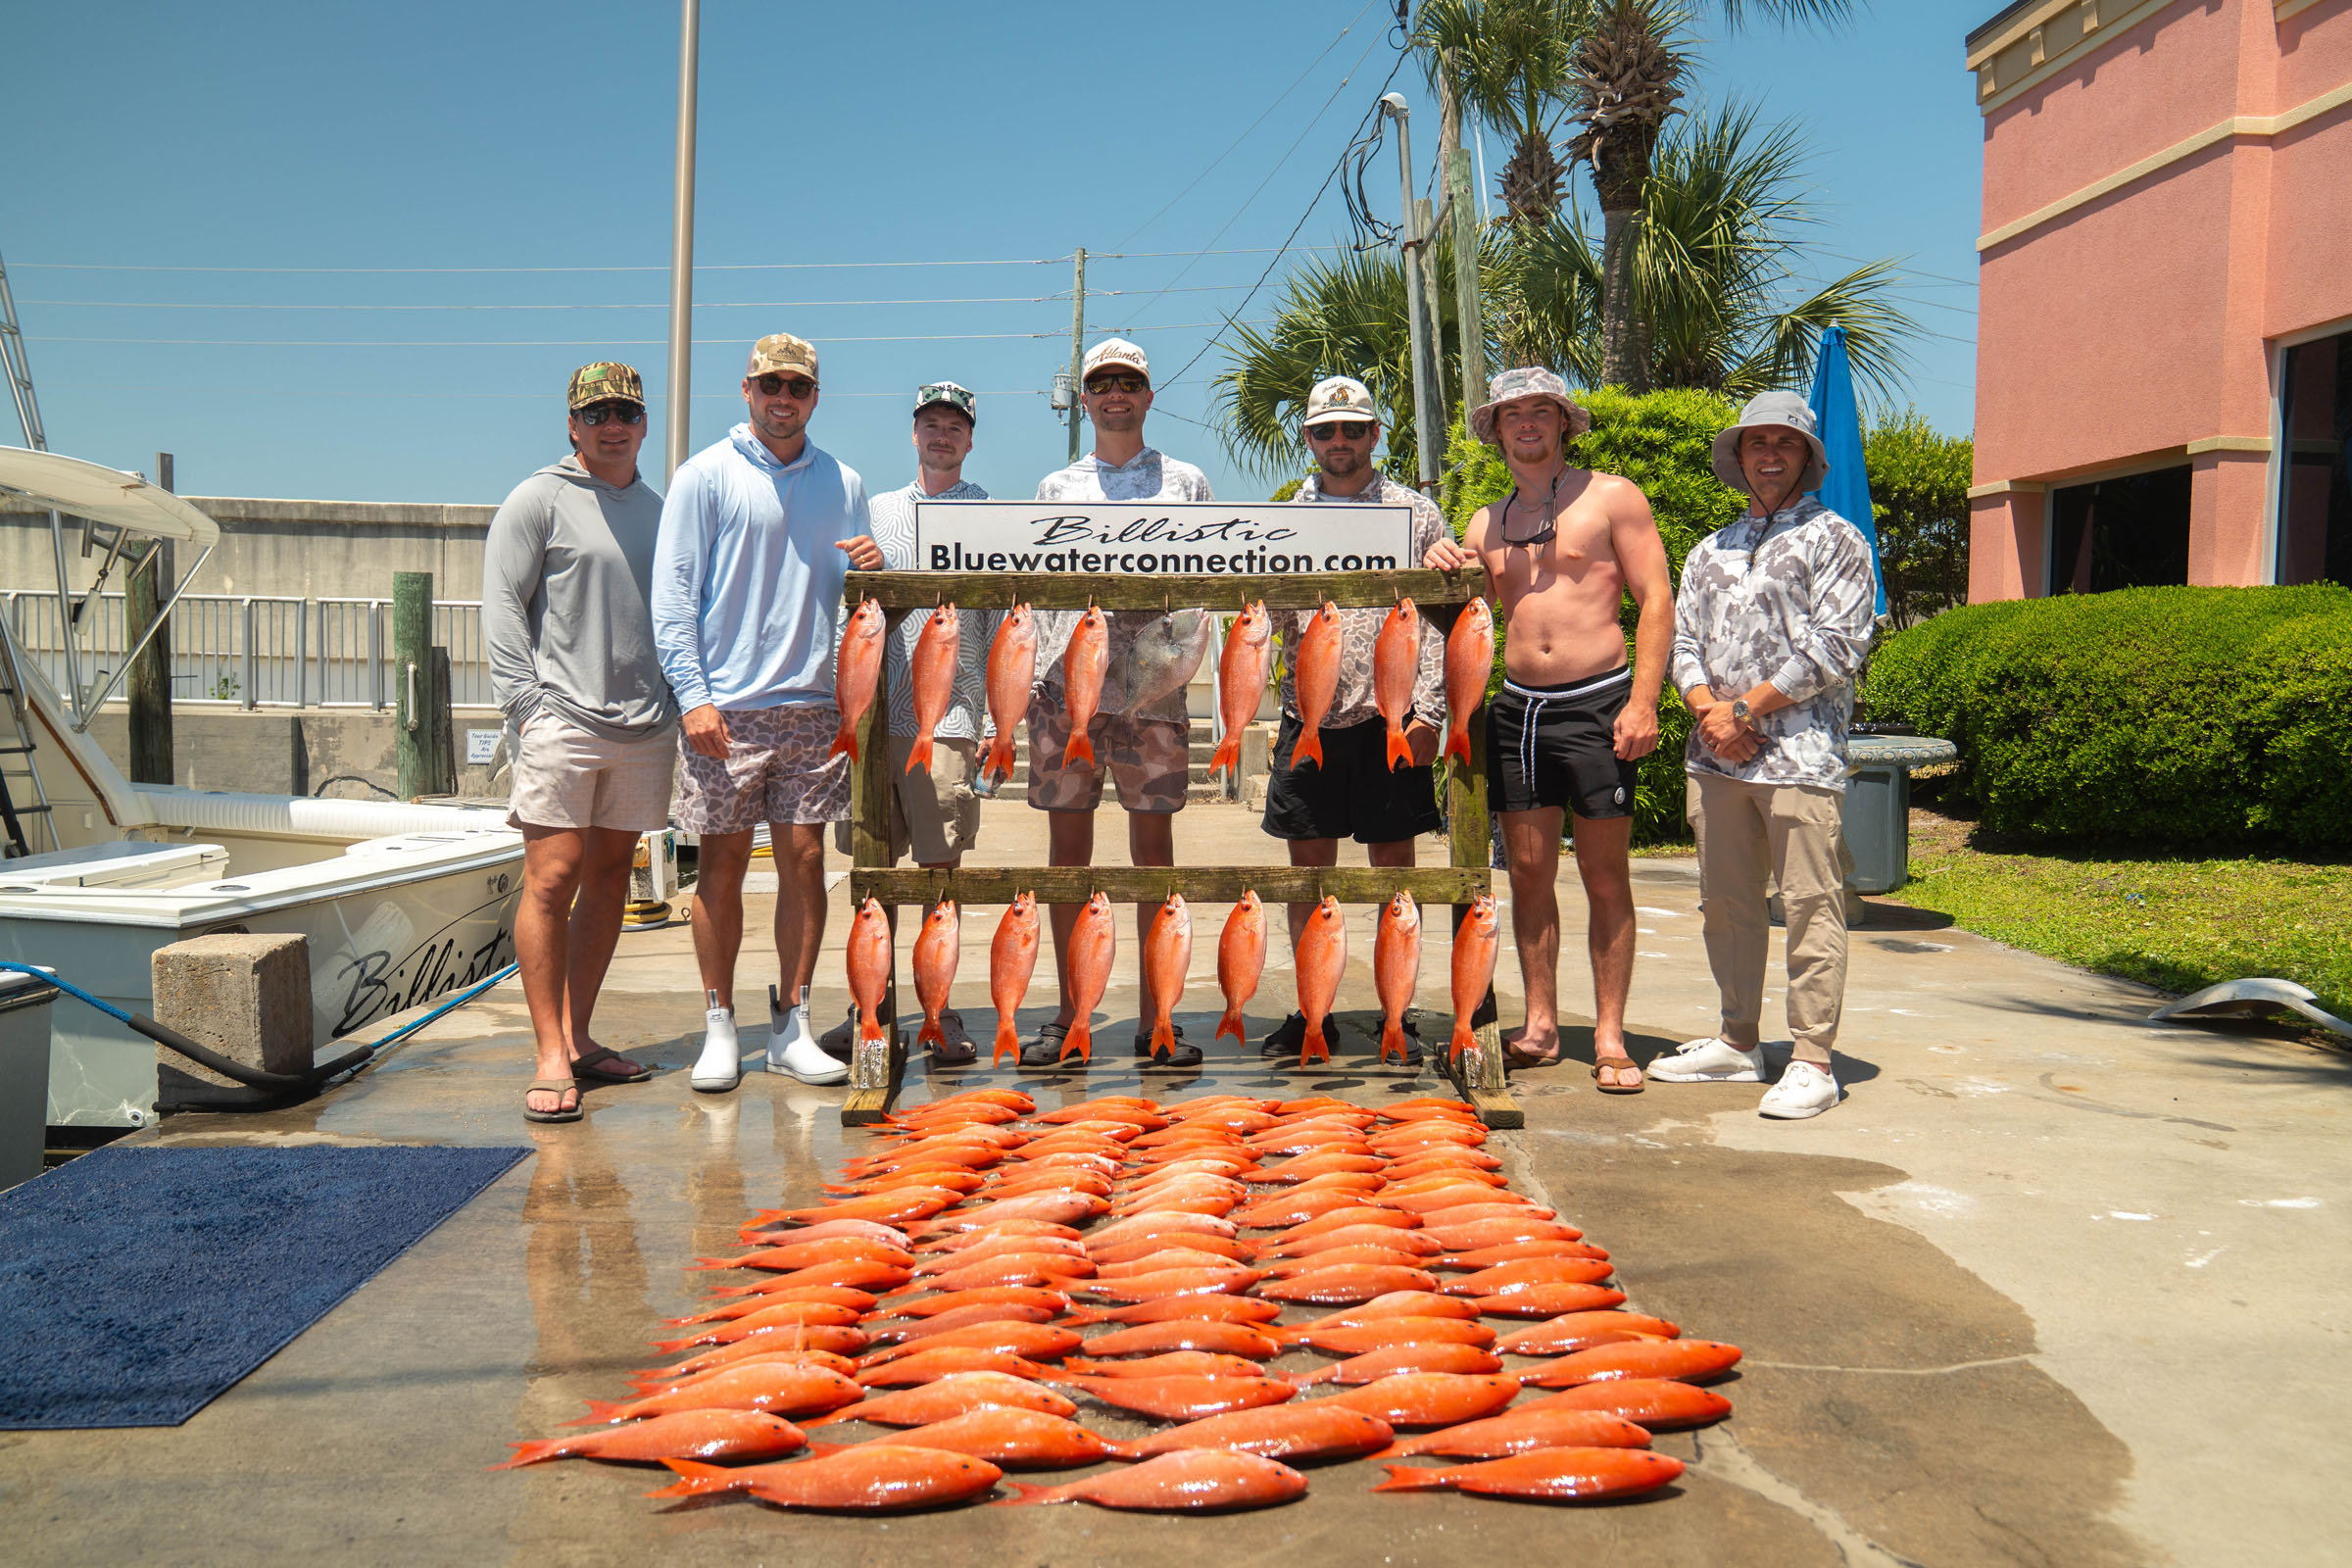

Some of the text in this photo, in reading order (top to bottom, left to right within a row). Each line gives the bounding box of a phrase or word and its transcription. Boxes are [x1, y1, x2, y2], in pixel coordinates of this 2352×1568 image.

[1089, 344, 1140, 369] Atlanta
[1030, 515, 1298, 546] Billistic
[930, 544, 1396, 572] Bluewaterconnection.com
